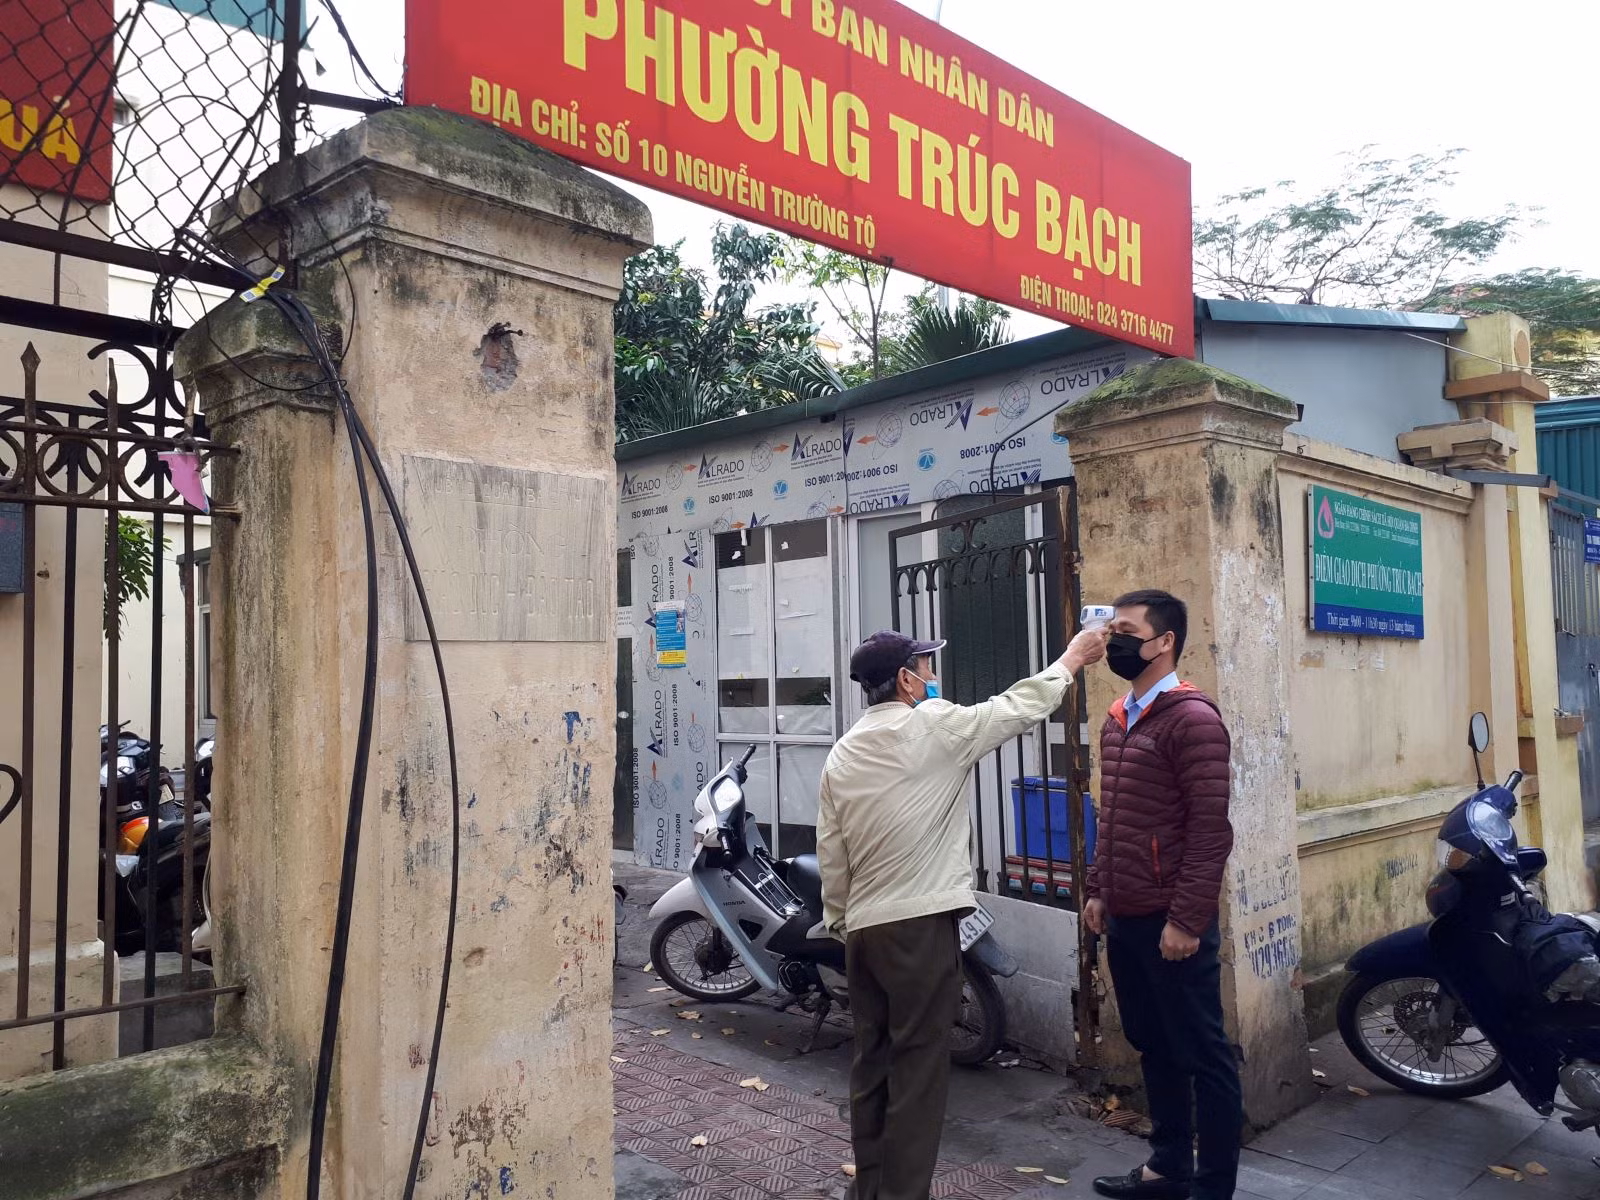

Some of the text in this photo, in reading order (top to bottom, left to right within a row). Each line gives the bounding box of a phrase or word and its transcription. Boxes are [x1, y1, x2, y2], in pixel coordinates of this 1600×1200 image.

[812, 0, 1054, 148] BAN NHÂN DÂN
[563, 0, 1141, 286] PHƯỜNG TRÚC BẠCH
[470, 75, 876, 256] ĐỊA CHỈ: SỐ 10 NGUYỄN TRƯỜNG TỘ
[1020, 275, 1174, 345] ĐIỆN THOẠI: 024 3716 4477
[791, 432, 843, 463] ALRADO
[1008, 436, 1027, 448] ISO
[698, 452, 745, 483] ALRADO
[805, 476, 817, 488] ISO
[882, 464, 898, 475] ISO
[631, 511, 641, 519] ISO
[708, 495, 720, 504] ISO
[682, 530, 698, 569] ALR
[1334, 557, 1350, 586] GIAO
[647, 689, 663, 757] ALRADO
[654, 817, 665, 867] LRADO
